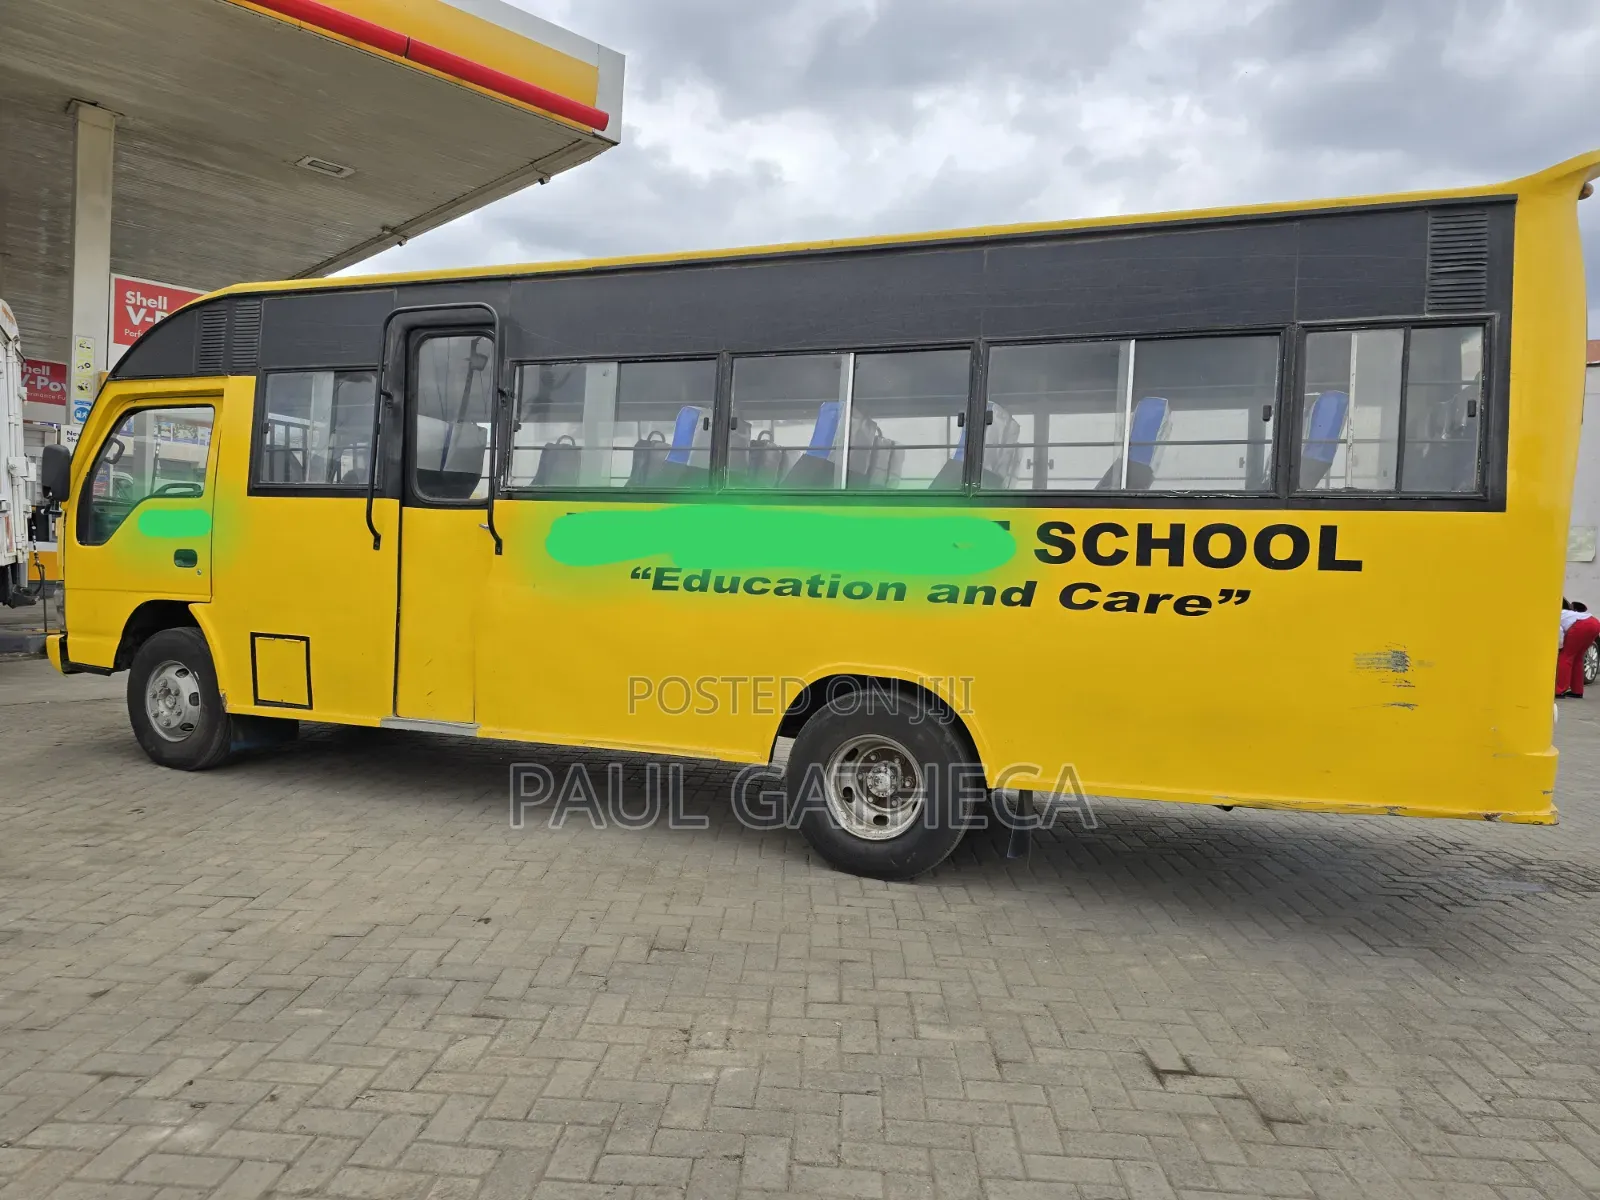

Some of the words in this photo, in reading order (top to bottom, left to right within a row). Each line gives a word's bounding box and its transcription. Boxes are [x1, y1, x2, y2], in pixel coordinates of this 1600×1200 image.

[125, 290, 168, 310] Shell
[1035, 522, 1362, 572] SCHOOL
[927, 579, 1037, 608] and
